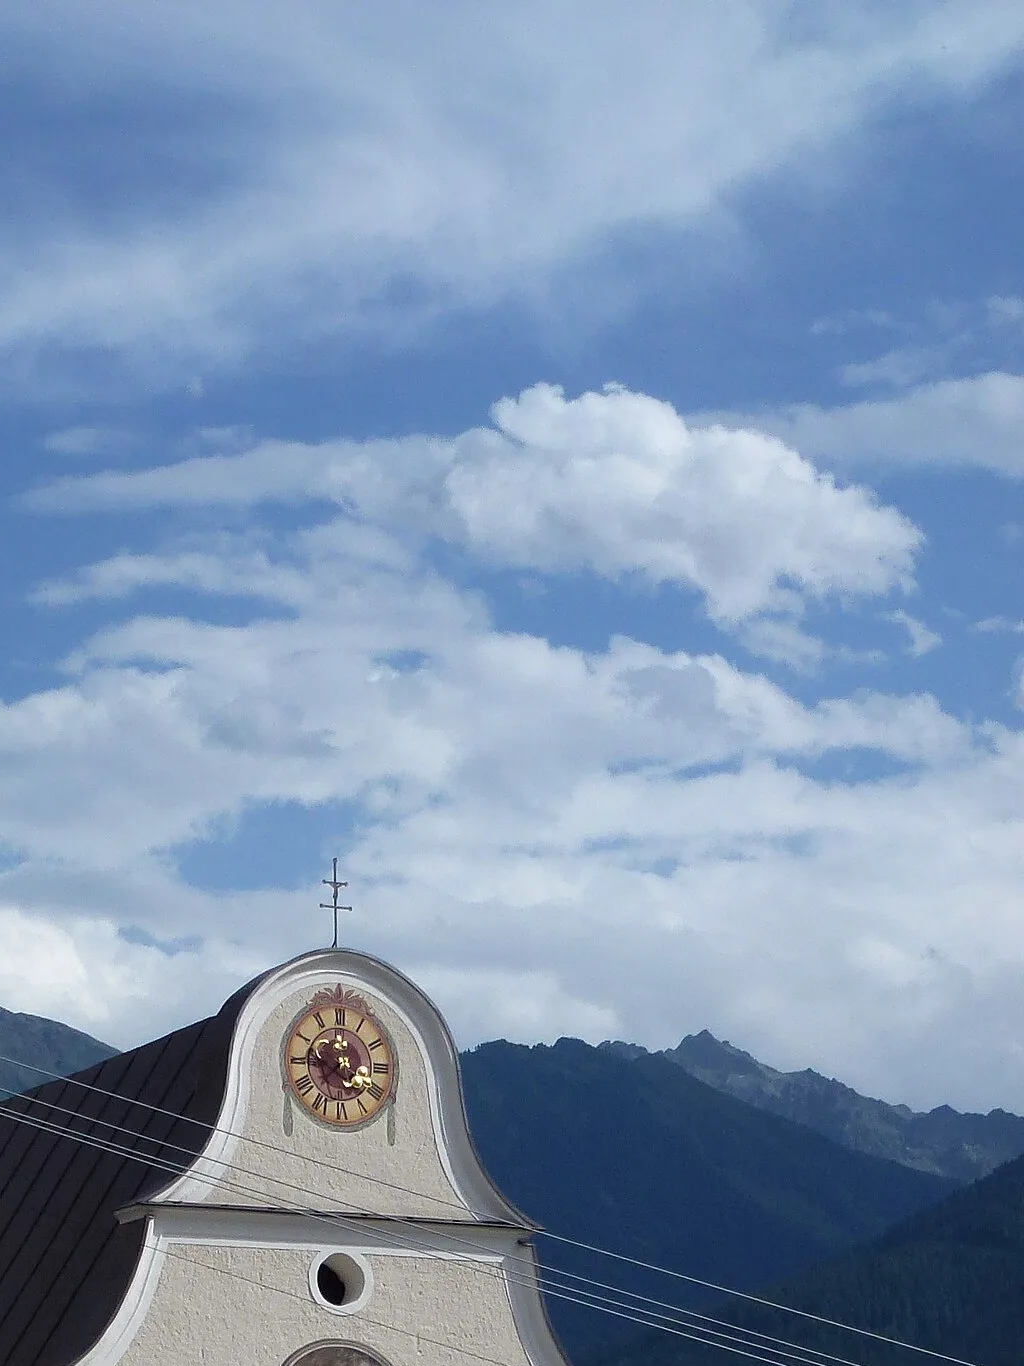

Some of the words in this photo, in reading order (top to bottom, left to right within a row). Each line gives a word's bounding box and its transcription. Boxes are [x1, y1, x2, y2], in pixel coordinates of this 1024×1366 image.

[335, 1008, 346, 1026] XII
[356, 1018, 365, 1033] I
[295, 1030, 311, 1045] X
[367, 1038, 384, 1051] II
[290, 1056, 306, 1064] IX
[373, 1063, 388, 1073] III
[295, 1074, 314, 1097] VIII
[312, 1093, 328, 1115] VII
[336, 1102, 348, 1120] VI
[356, 1098, 368, 1116] V
